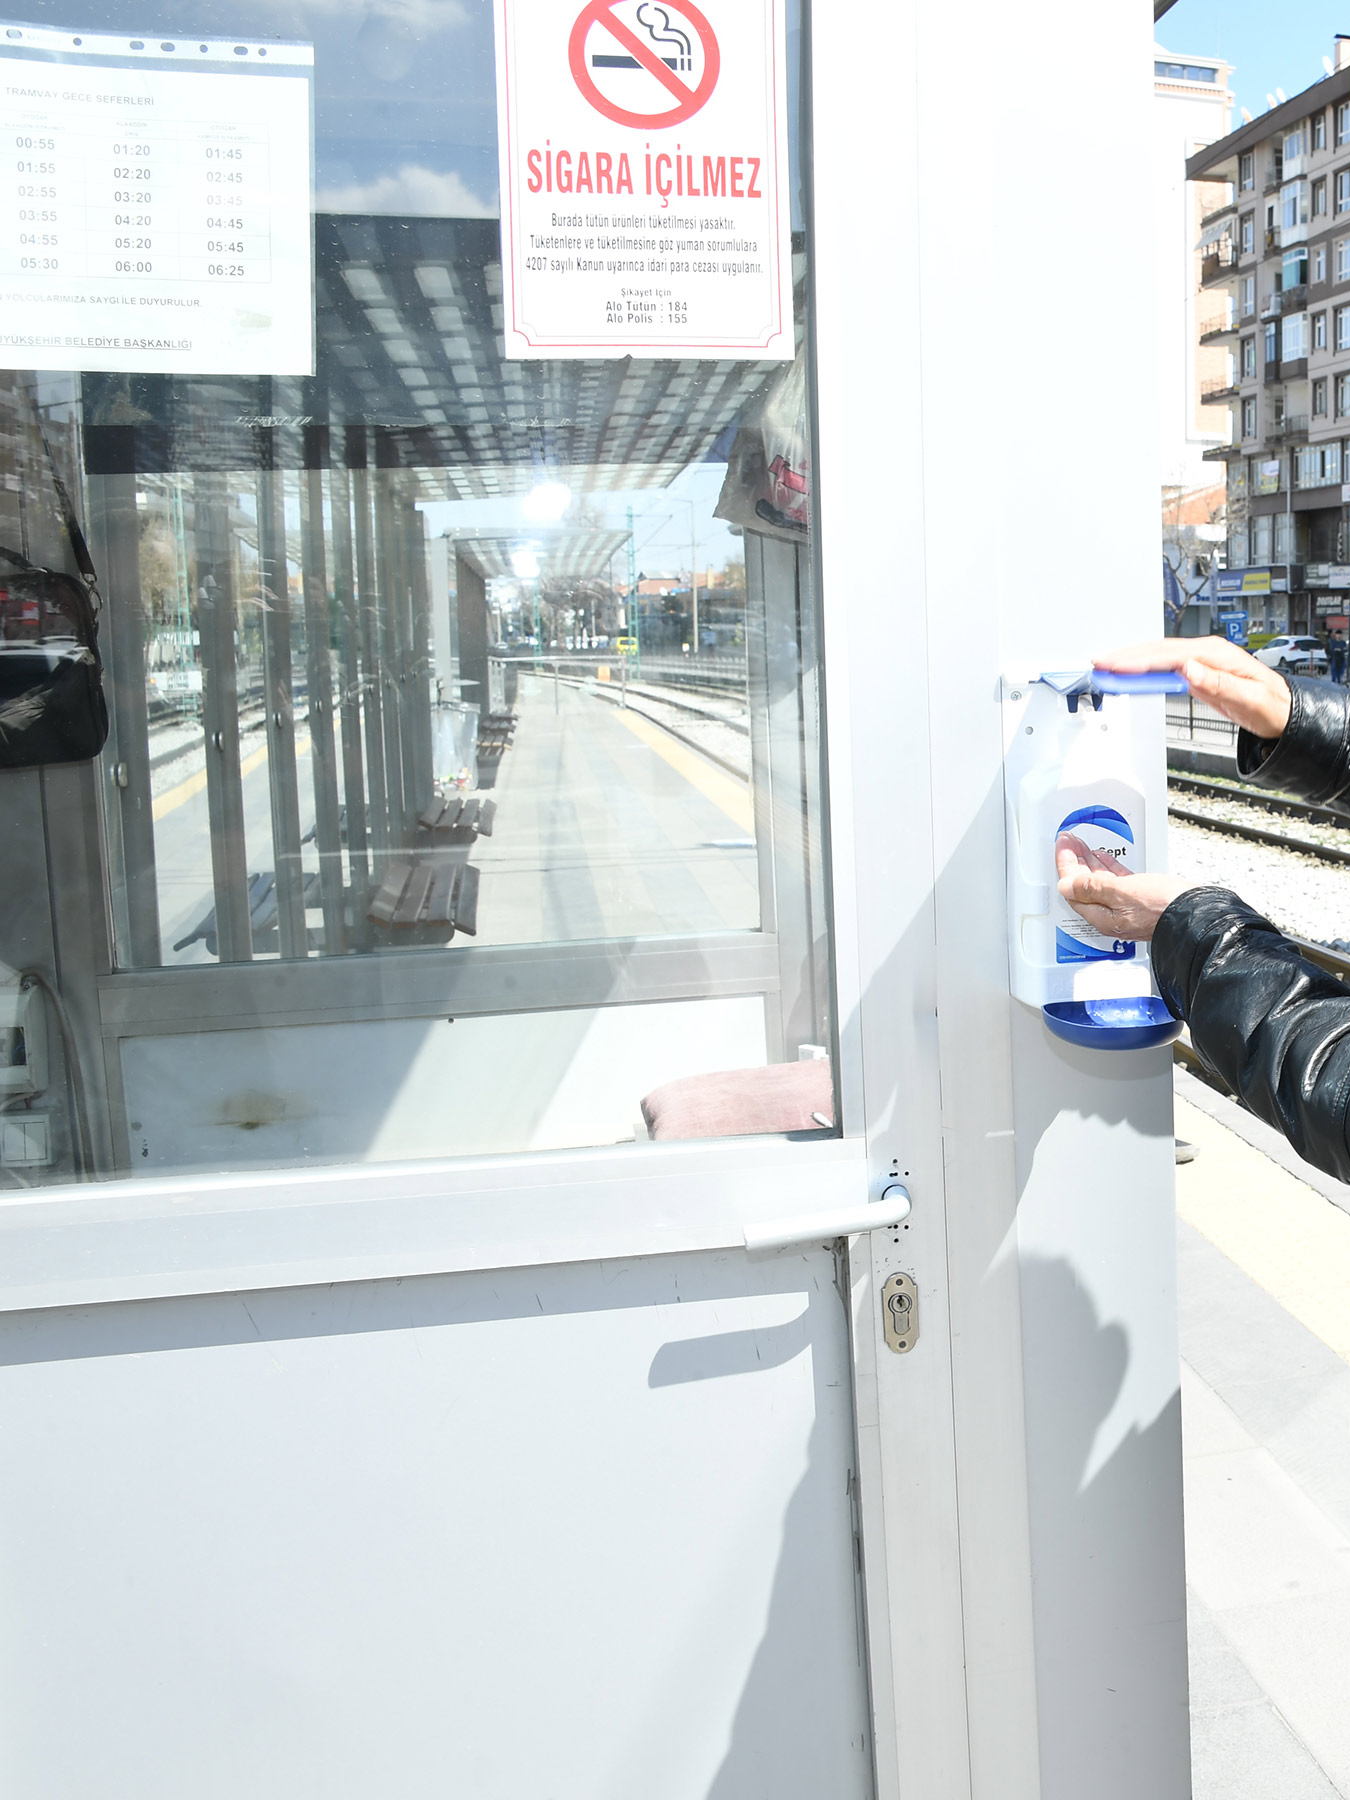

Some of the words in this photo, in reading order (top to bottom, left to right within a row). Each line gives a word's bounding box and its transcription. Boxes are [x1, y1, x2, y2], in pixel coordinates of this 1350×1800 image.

[5, 87, 58, 99] TRAMVAY
[62, 92, 93, 103] GECE
[96, 94, 155, 106] SEFERLERİ
[16, 136, 56, 150] 00:55
[113, 144, 151, 156] 01:20
[205, 147, 243, 160] 01:45
[17, 161, 56, 174] 01:55
[113, 167, 151, 180] 02:20
[206, 171, 243, 184] 02:45
[527, 139, 634, 195] SİGARA
[645, 143, 762, 208] İÇİLMEZ
[18, 185, 57, 198] 02:55
[114, 191, 152, 204] 03:20
[206, 194, 243, 206] 03:45
[19, 209, 58, 222] 03:55
[114, 214, 152, 226] 04:20
[206, 217, 244, 230] 04:45
[551, 213, 583, 227] Burada
[586, 214, 609, 228] tütün
[612, 215, 646, 228] ürünleri
[649, 215, 697, 230] tüketilmesi
[700, 217, 736, 232] yasaktır.
[19, 233, 58, 246] 04:55
[115, 237, 152, 249] 05:20
[207, 241, 244, 253] 05:45
[530, 235, 582, 249] Tüketenlere
[584, 239, 595, 249] ve
[597, 236, 656, 250] tüketilmesine
[659, 238, 674, 253] göz
[676, 241, 705, 253] yuman
[707, 239, 758, 252] sorumlulara
[20, 257, 59, 270] 05:30
[115, 260, 153, 273] 06:00
[208, 264, 245, 277] 06:25
[525, 257, 548, 271] 4207
[550, 258, 574, 274] sayılı
[576, 257, 605, 271] Kanun
[607, 260, 645, 274] uyarınca
[647, 258, 667, 272] idari
[670, 262, 690, 275] para
[692, 261, 720, 272] cezası
[722, 261, 763, 276] uygulanır.
[6, 293, 86, 303] YOLCULARIMIZA
[90, 296, 119, 305] SAYGI
[620, 287, 653, 298] Şikayet
[605, 301, 623, 312] Alo
[626, 301, 657, 312] Tütün
[668, 301, 688, 312] 184
[606, 313, 624, 324] Alo
[627, 313, 654, 324] Polis
[668, 313, 688, 324] 155
[65, 336, 121, 347] BELEDİYE
[124, 338, 192, 350] BAŞKANLIĞI
[1230, 623, 1240, 637] P
